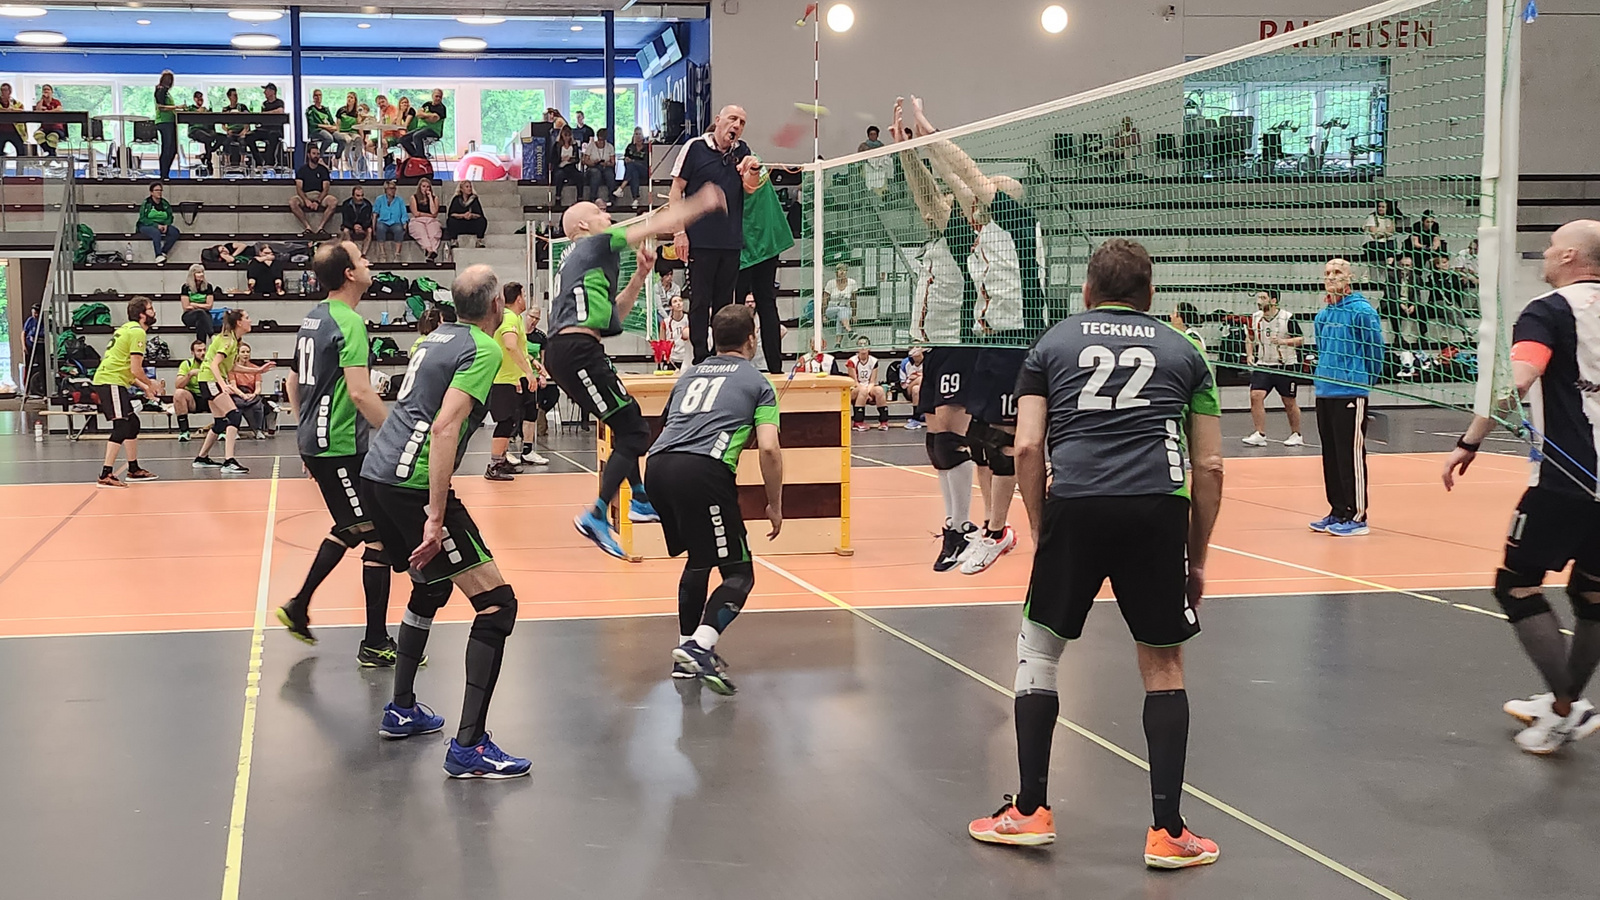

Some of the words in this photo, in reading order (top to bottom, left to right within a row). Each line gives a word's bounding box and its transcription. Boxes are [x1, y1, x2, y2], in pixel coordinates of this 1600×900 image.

[1080, 321, 1156, 338] TECKNAU
[298, 336, 316, 386] 12
[396, 347, 427, 400] 8
[695, 364, 740, 374] TECKNAU
[1077, 345, 1157, 410] 22
[679, 376, 727, 414] 81
[940, 372, 960, 394] 69
